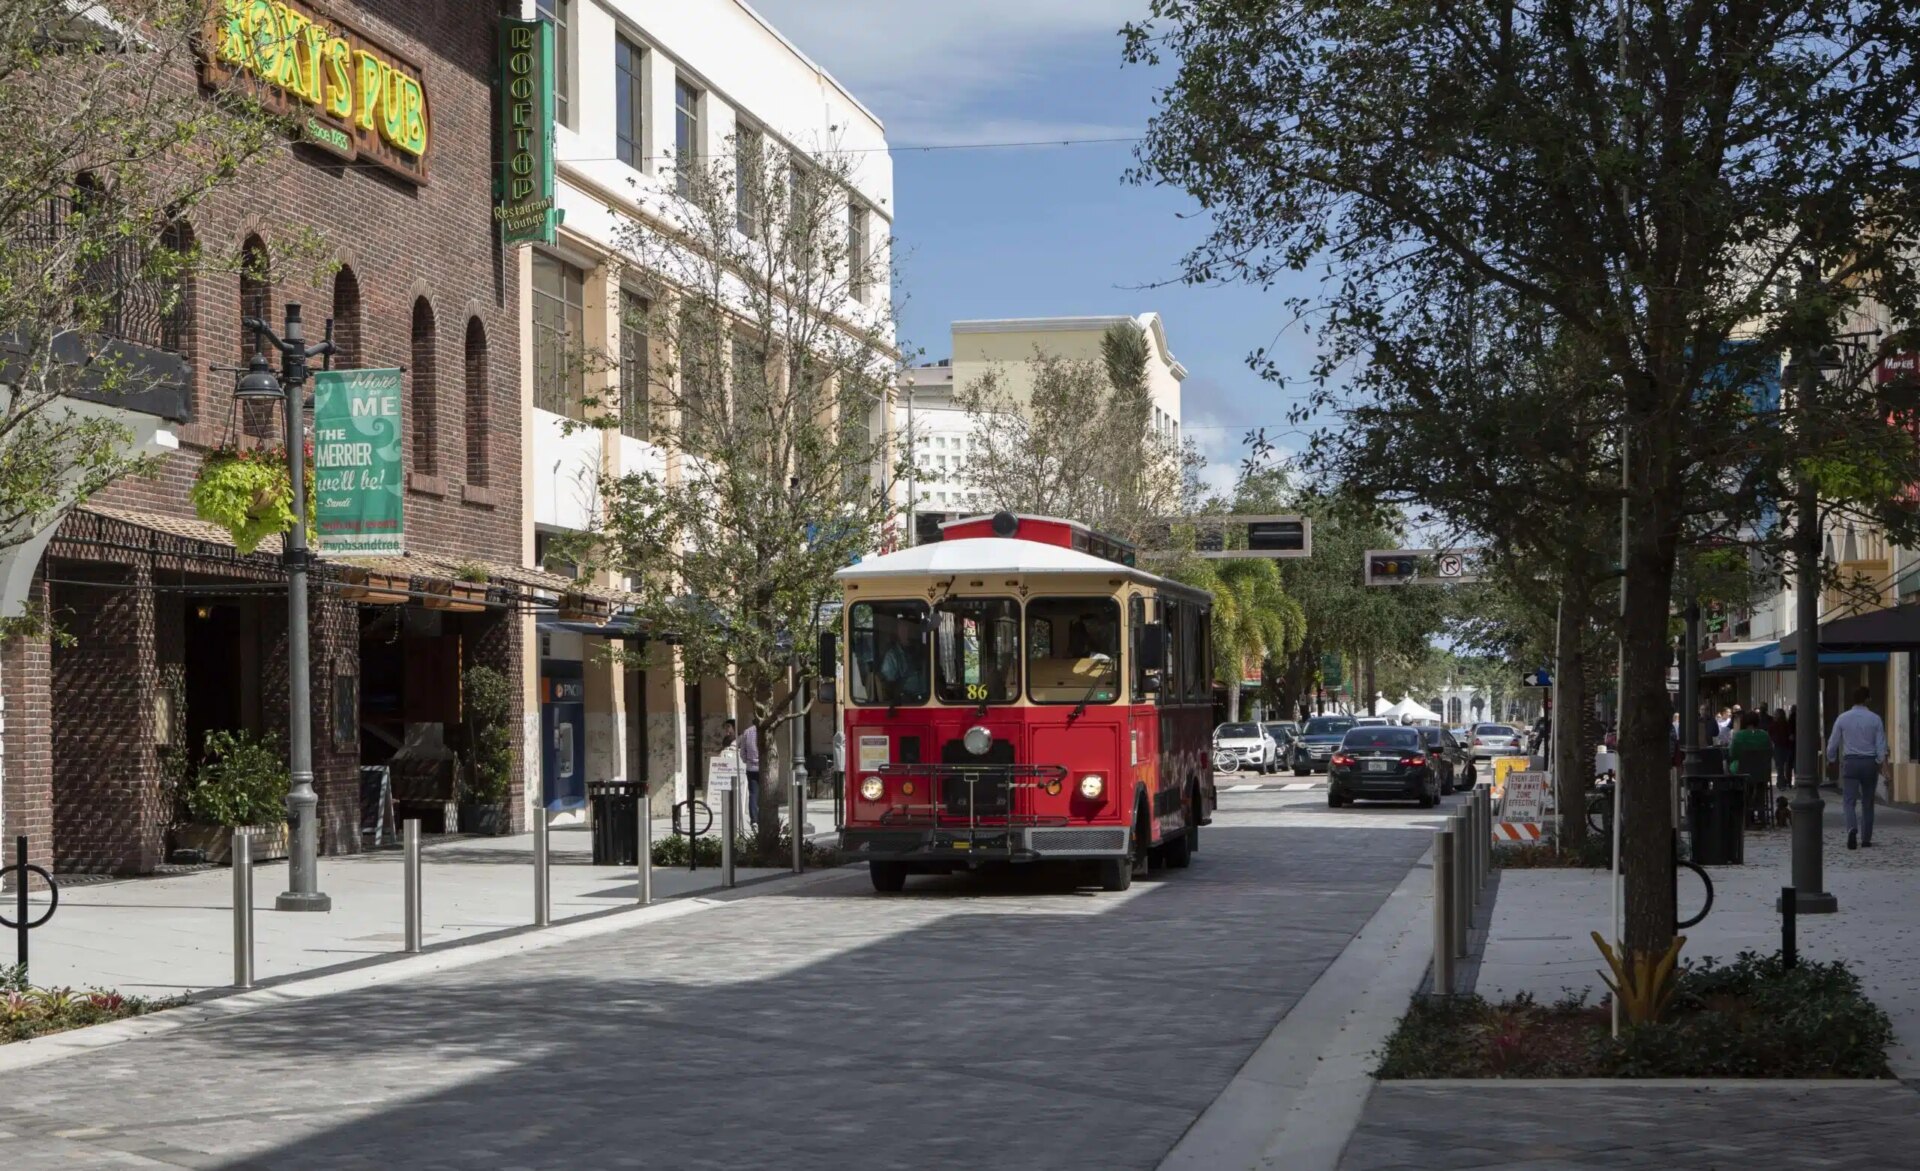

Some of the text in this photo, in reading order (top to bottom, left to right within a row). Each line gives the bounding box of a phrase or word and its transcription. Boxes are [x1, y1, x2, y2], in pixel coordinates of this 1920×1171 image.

[353, 50, 426, 156] PUB
[510, 27, 536, 199] ROOFTOP
[494, 195, 553, 220] Restaurant
[507, 213, 545, 231] Lounge
[351, 372, 398, 389] More
[352, 396, 398, 416] ME
[317, 429, 347, 441] THE
[317, 443, 373, 467] MERRIER
[318, 468, 385, 491] we'll be!
[967, 684, 988, 700] 86
[1508, 799, 1537, 807] EFFECTIVE
